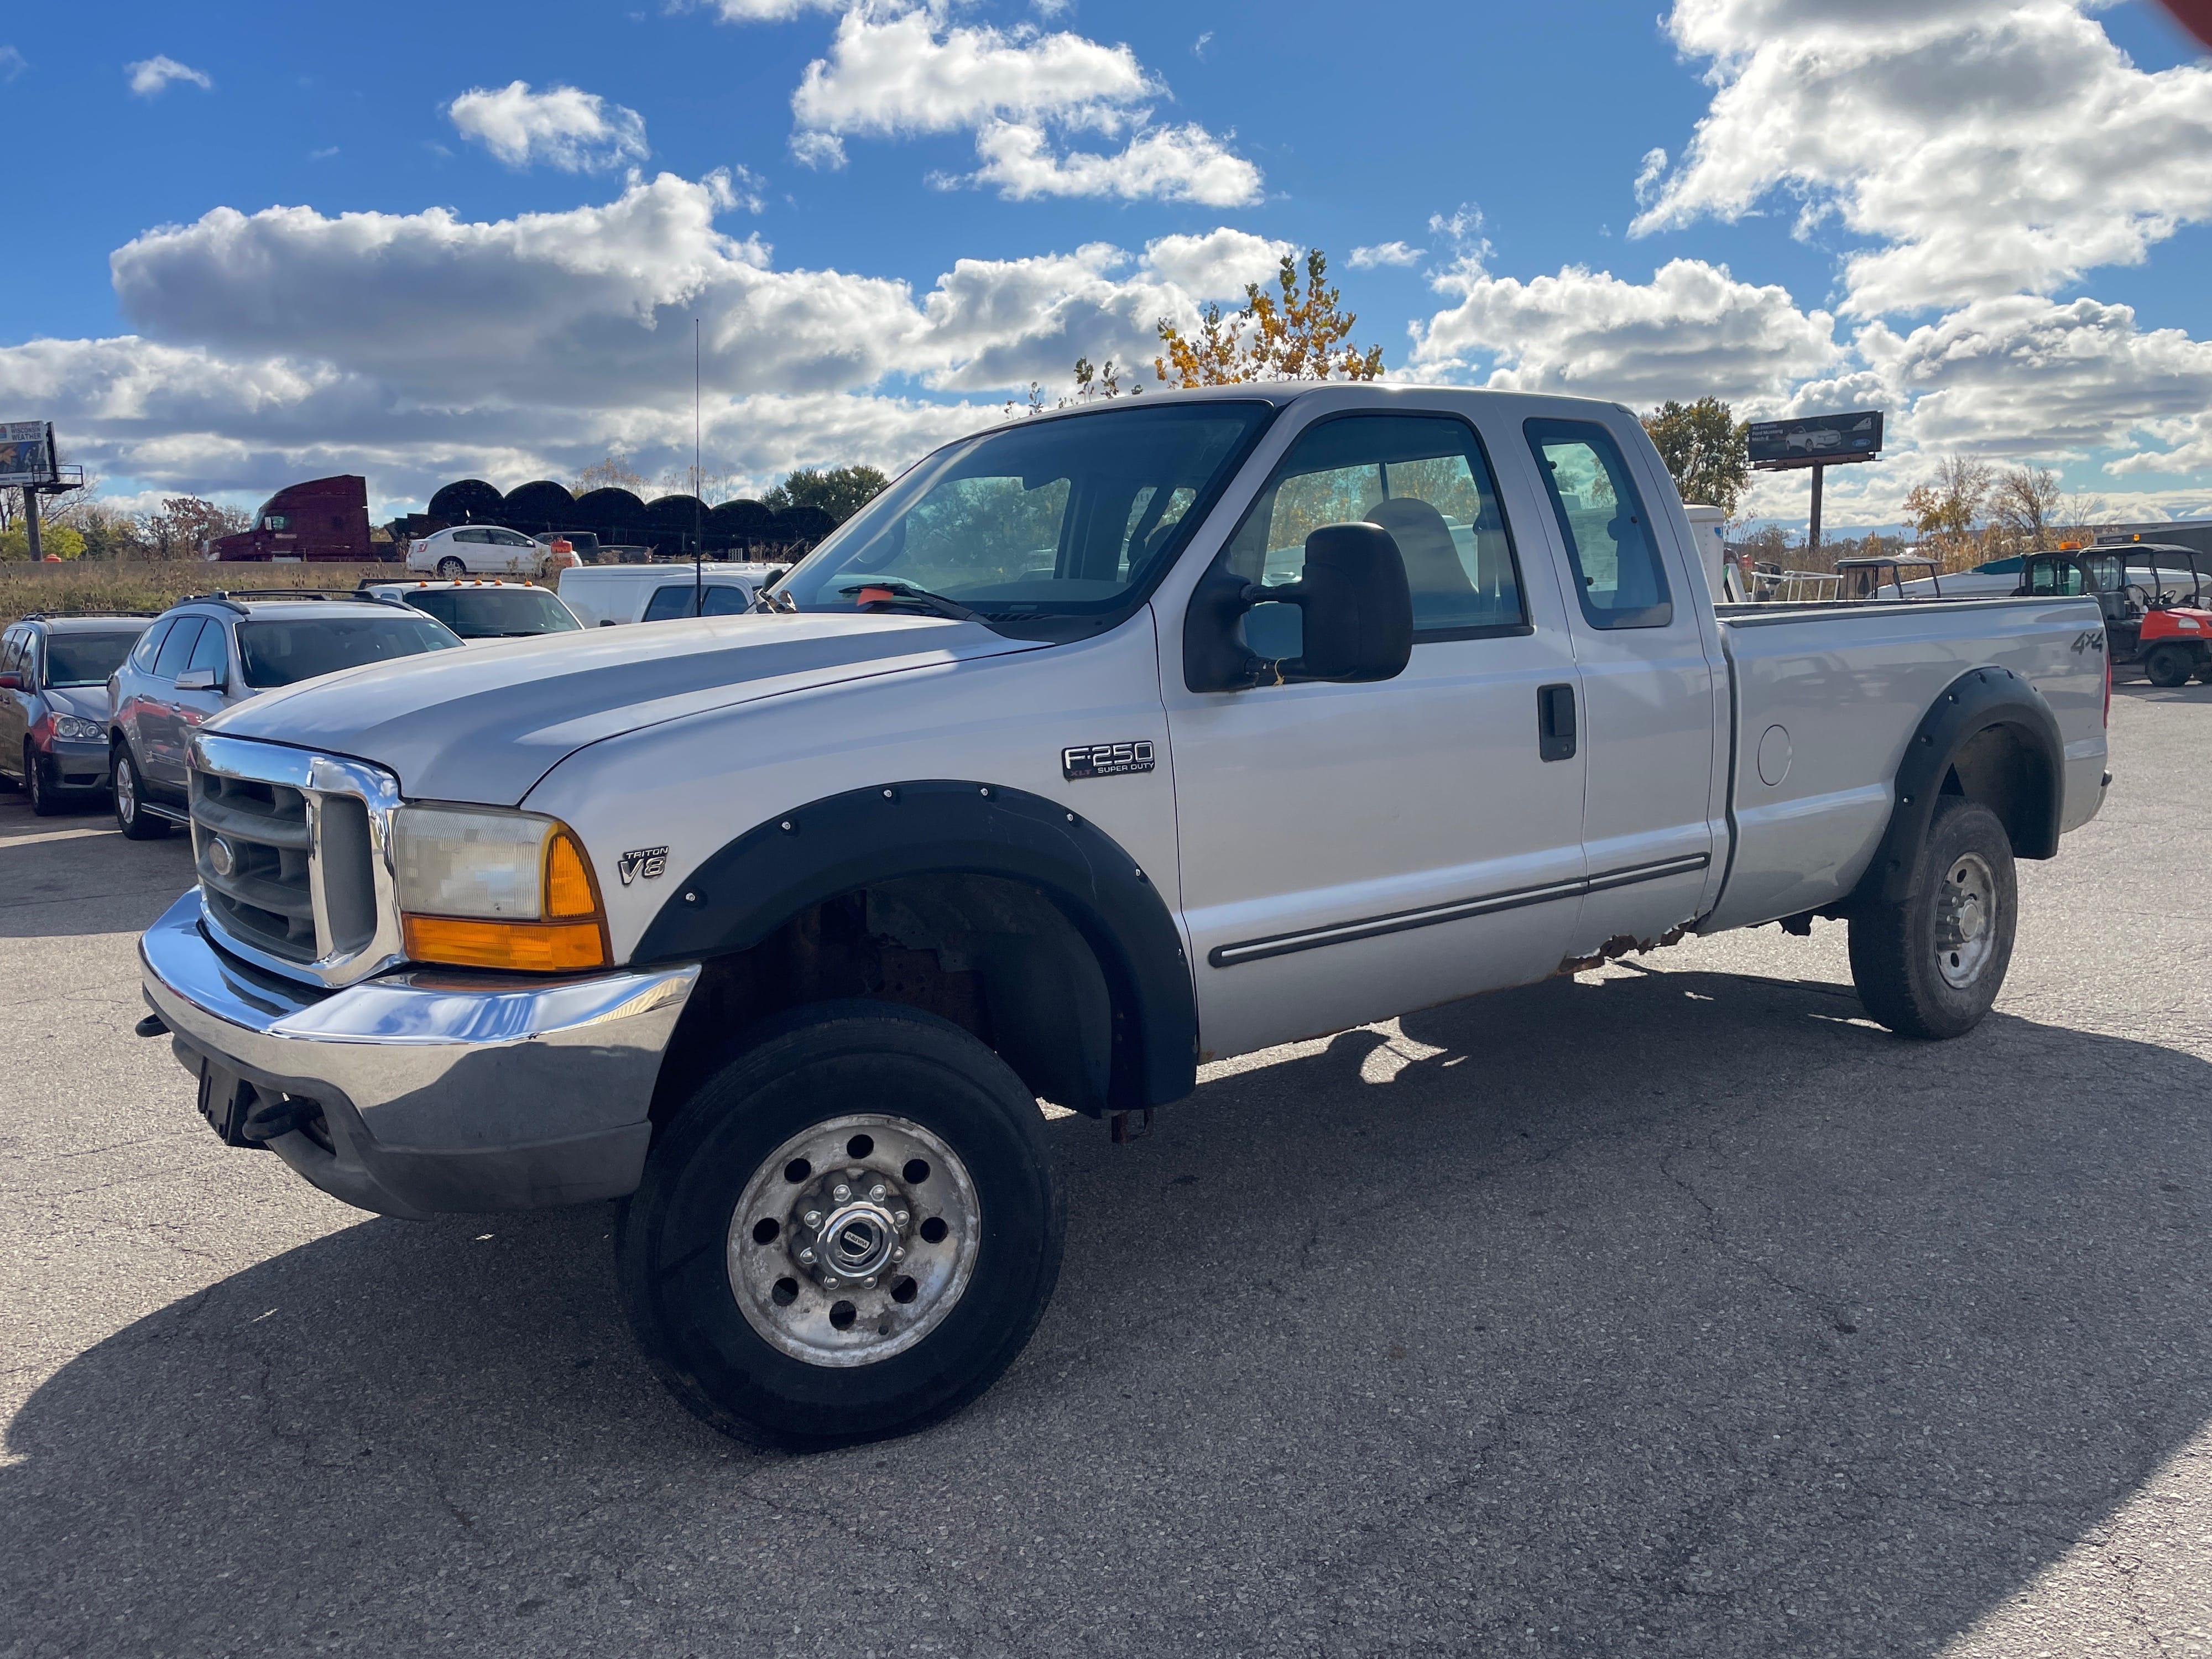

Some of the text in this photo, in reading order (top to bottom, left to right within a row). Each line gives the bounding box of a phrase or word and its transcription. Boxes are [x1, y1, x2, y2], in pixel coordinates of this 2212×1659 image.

[1097, 764, 1128, 774] SUPER
[1130, 762, 1154, 770] DUTY
[625, 847, 669, 859] TRITON
[619, 856, 666, 884] V8
[847, 1234, 867, 1247] WARN
